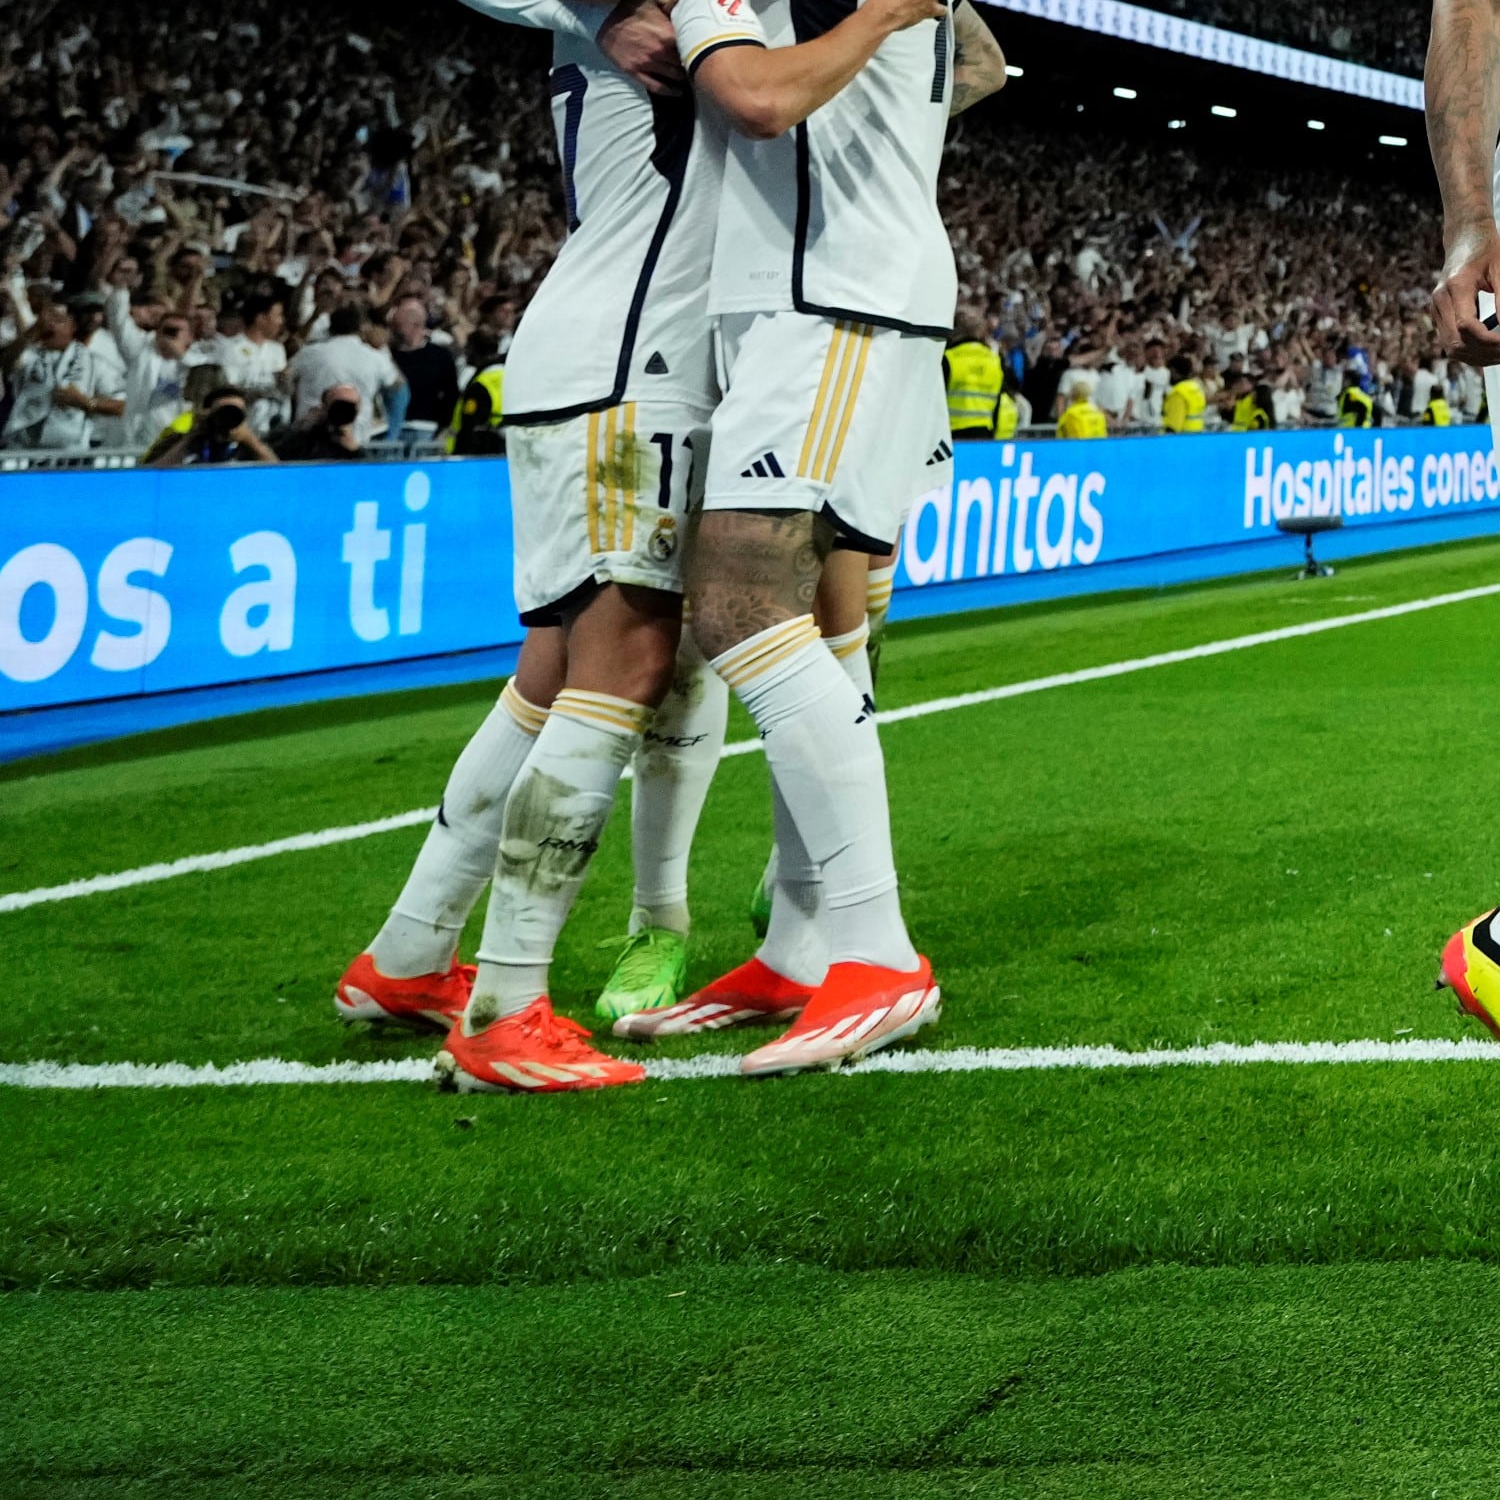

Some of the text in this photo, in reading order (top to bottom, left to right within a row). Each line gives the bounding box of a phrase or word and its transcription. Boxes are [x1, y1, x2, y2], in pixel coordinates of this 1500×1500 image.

[903, 445, 1105, 586] anitas
[1244, 433, 1500, 529] Hospitales conec
[0, 471, 431, 683] os a ti
